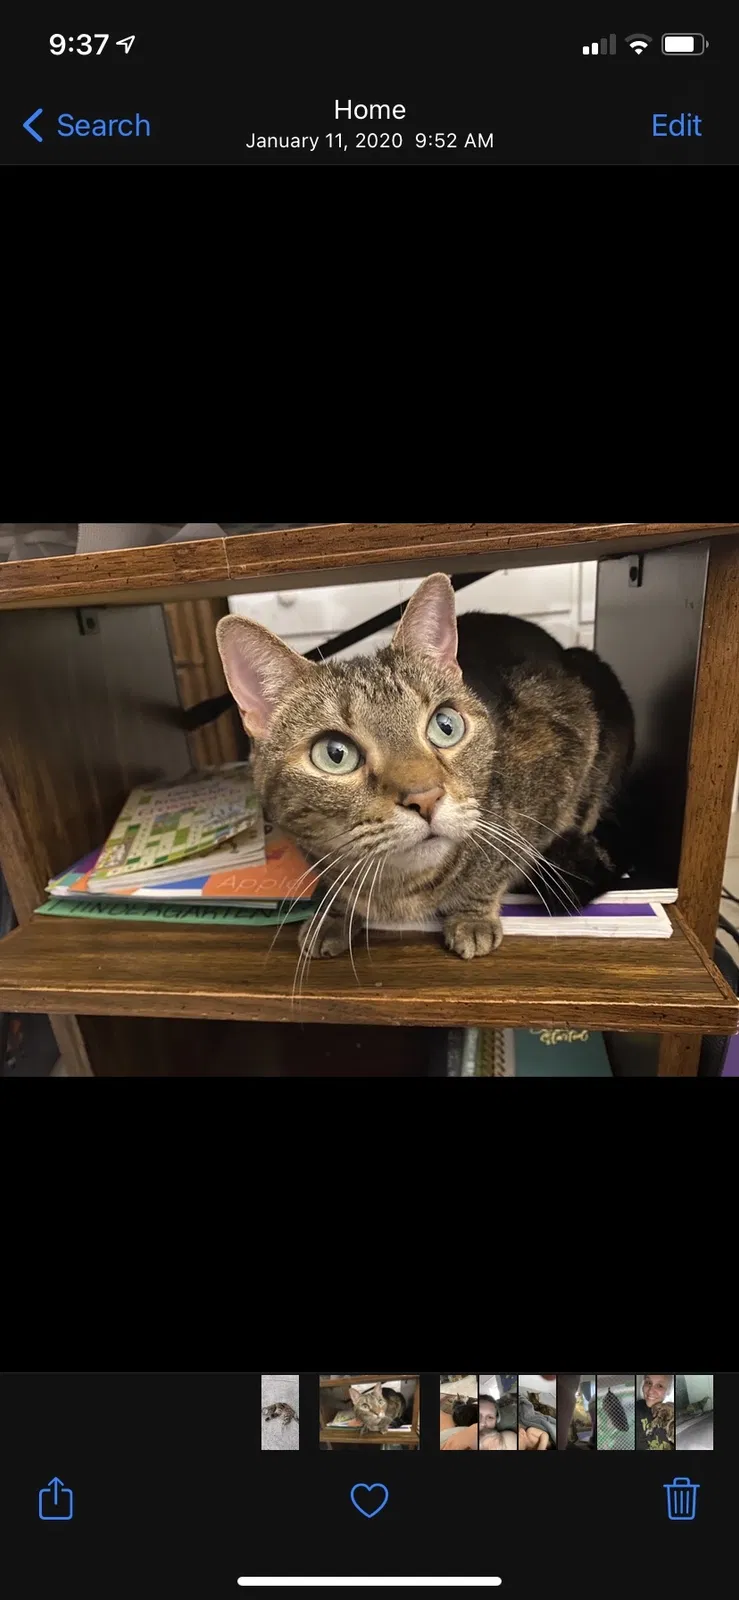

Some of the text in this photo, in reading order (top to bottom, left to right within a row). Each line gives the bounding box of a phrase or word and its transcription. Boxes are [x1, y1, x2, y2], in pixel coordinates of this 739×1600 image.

[49, 33, 110, 56] 9:37
[334, 99, 406, 120] Home
[57, 112, 151, 137] Search
[652, 112, 703, 137] Edit
[245, 132, 494, 152] January 11, 2020 9:52 AM
